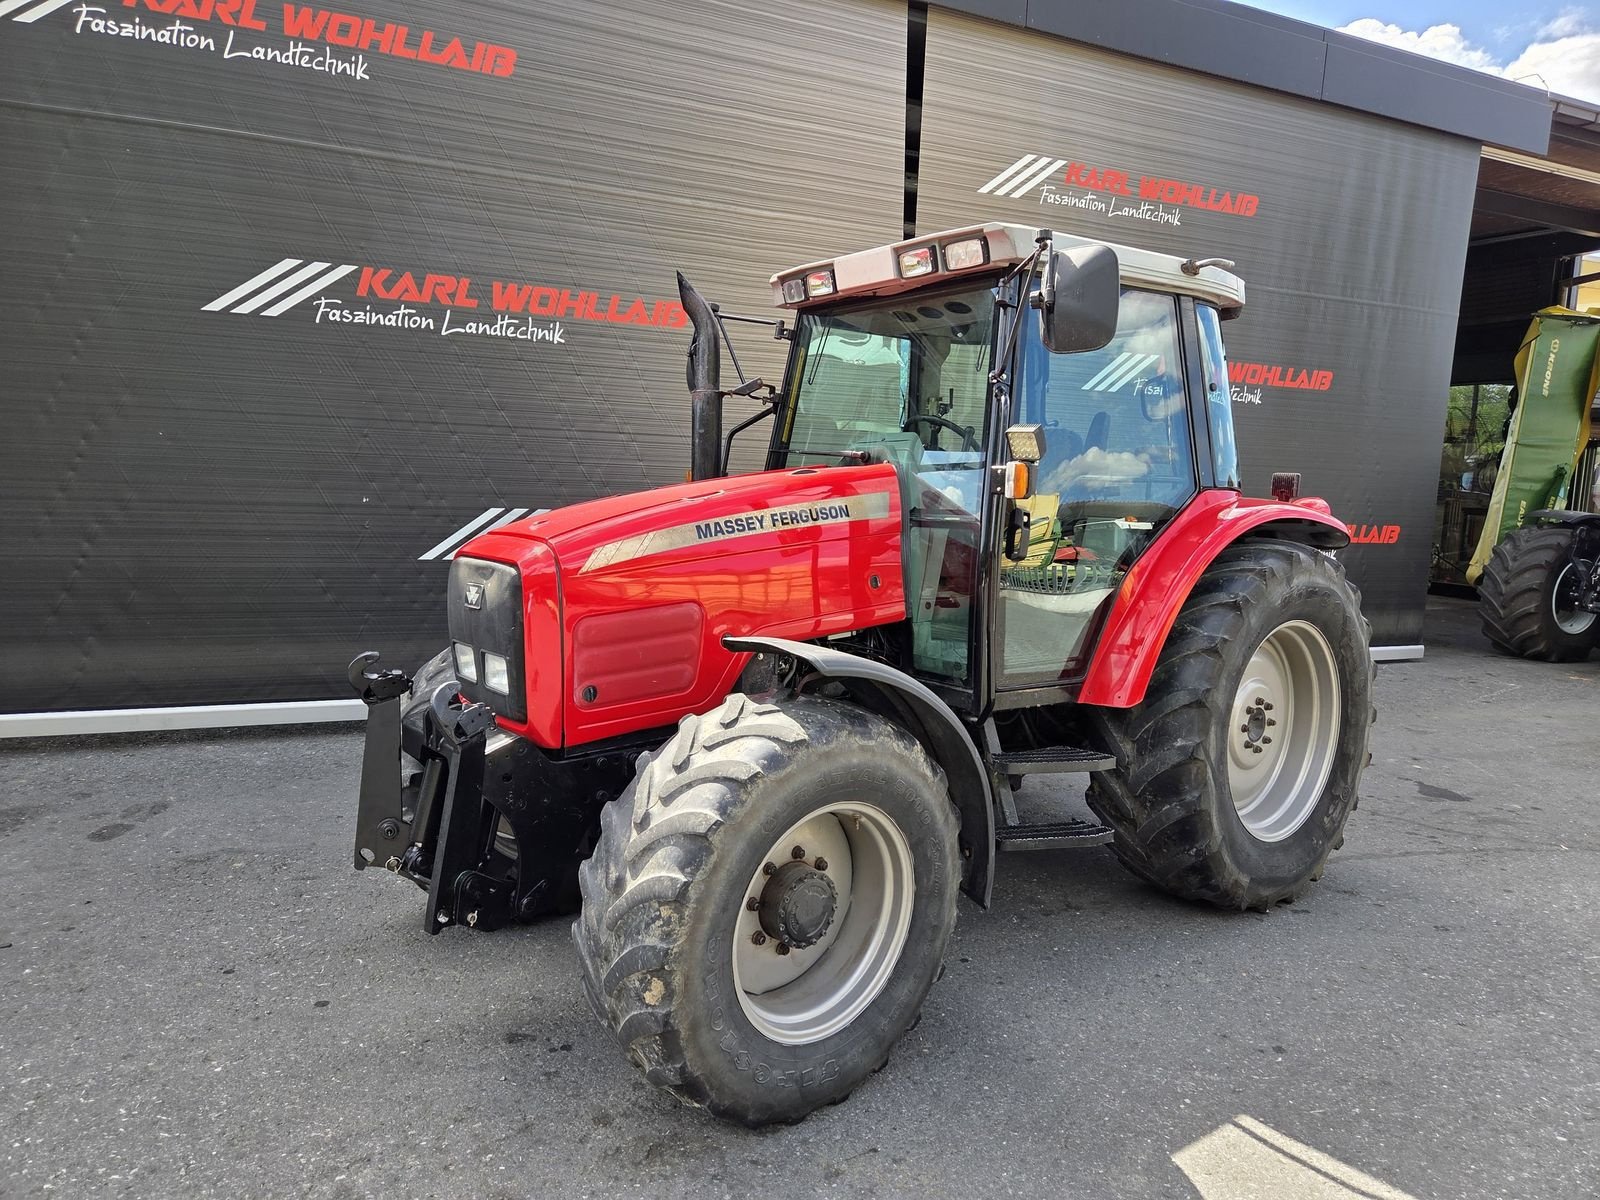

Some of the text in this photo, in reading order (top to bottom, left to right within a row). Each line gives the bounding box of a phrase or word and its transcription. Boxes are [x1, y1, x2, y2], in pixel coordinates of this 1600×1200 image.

[72, 3, 370, 81] Faszination Landtechnik
[1064, 161, 1132, 197] KARL
[1039, 183, 1181, 226] Faszination Landtechnik
[356, 266, 479, 309] KARL
[312, 296, 566, 345] Faszination Landtechnik
[694, 503, 851, 541] MASSEY FERGUSON
